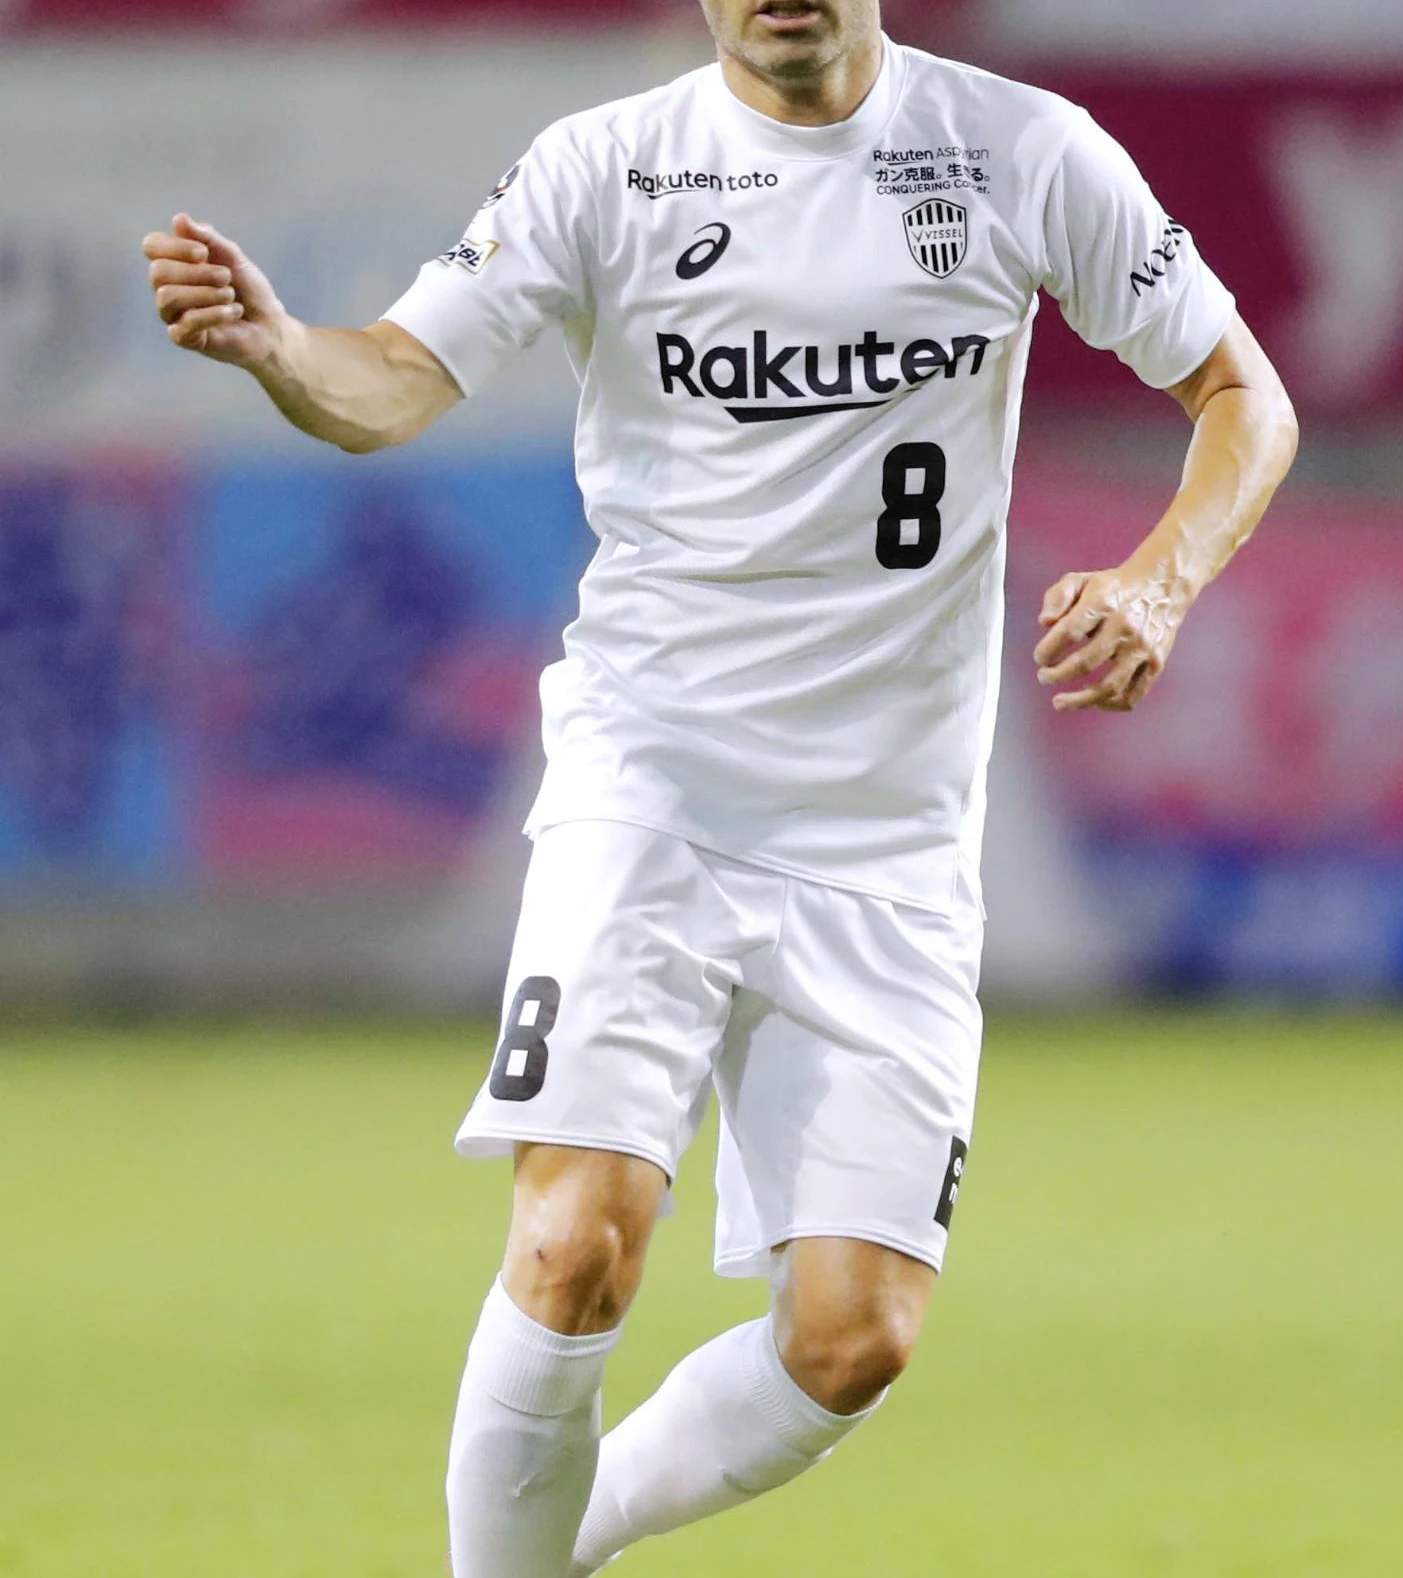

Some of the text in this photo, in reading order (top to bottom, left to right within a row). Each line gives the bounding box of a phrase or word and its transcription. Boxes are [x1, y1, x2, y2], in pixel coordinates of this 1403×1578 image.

[873, 149, 933, 161] Rakuten
[627, 169, 779, 194] Rakuten toto
[876, 181, 950, 195] CONQUERING
[925, 229, 963, 240] VISSEL
[656, 329, 991, 400] Rakuten
[875, 441, 947, 570] 8
[488, 976, 561, 1102] 8
